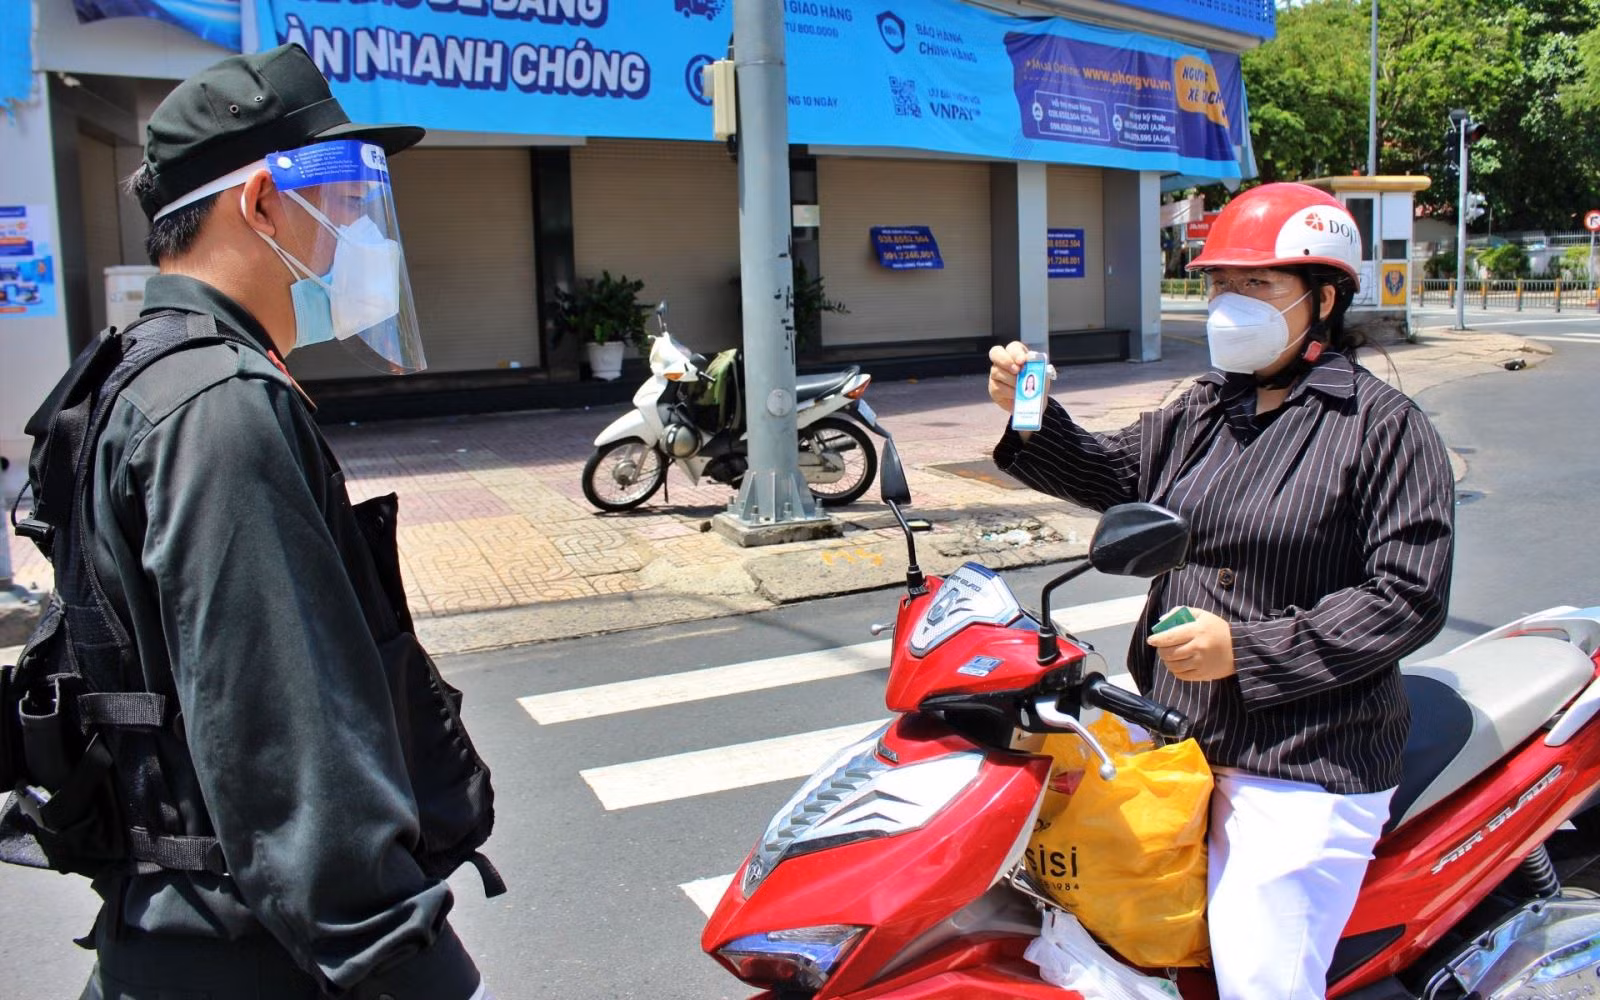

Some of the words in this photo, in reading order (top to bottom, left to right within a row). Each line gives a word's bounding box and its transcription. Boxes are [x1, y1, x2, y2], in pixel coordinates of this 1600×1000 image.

[790, 0, 819, 17] GIAO
[355, 27, 507, 90] NHANH
[511, 39, 650, 98] CHÓNG
[802, 95, 812, 107] 10
[929, 101, 974, 121] VNPAY
